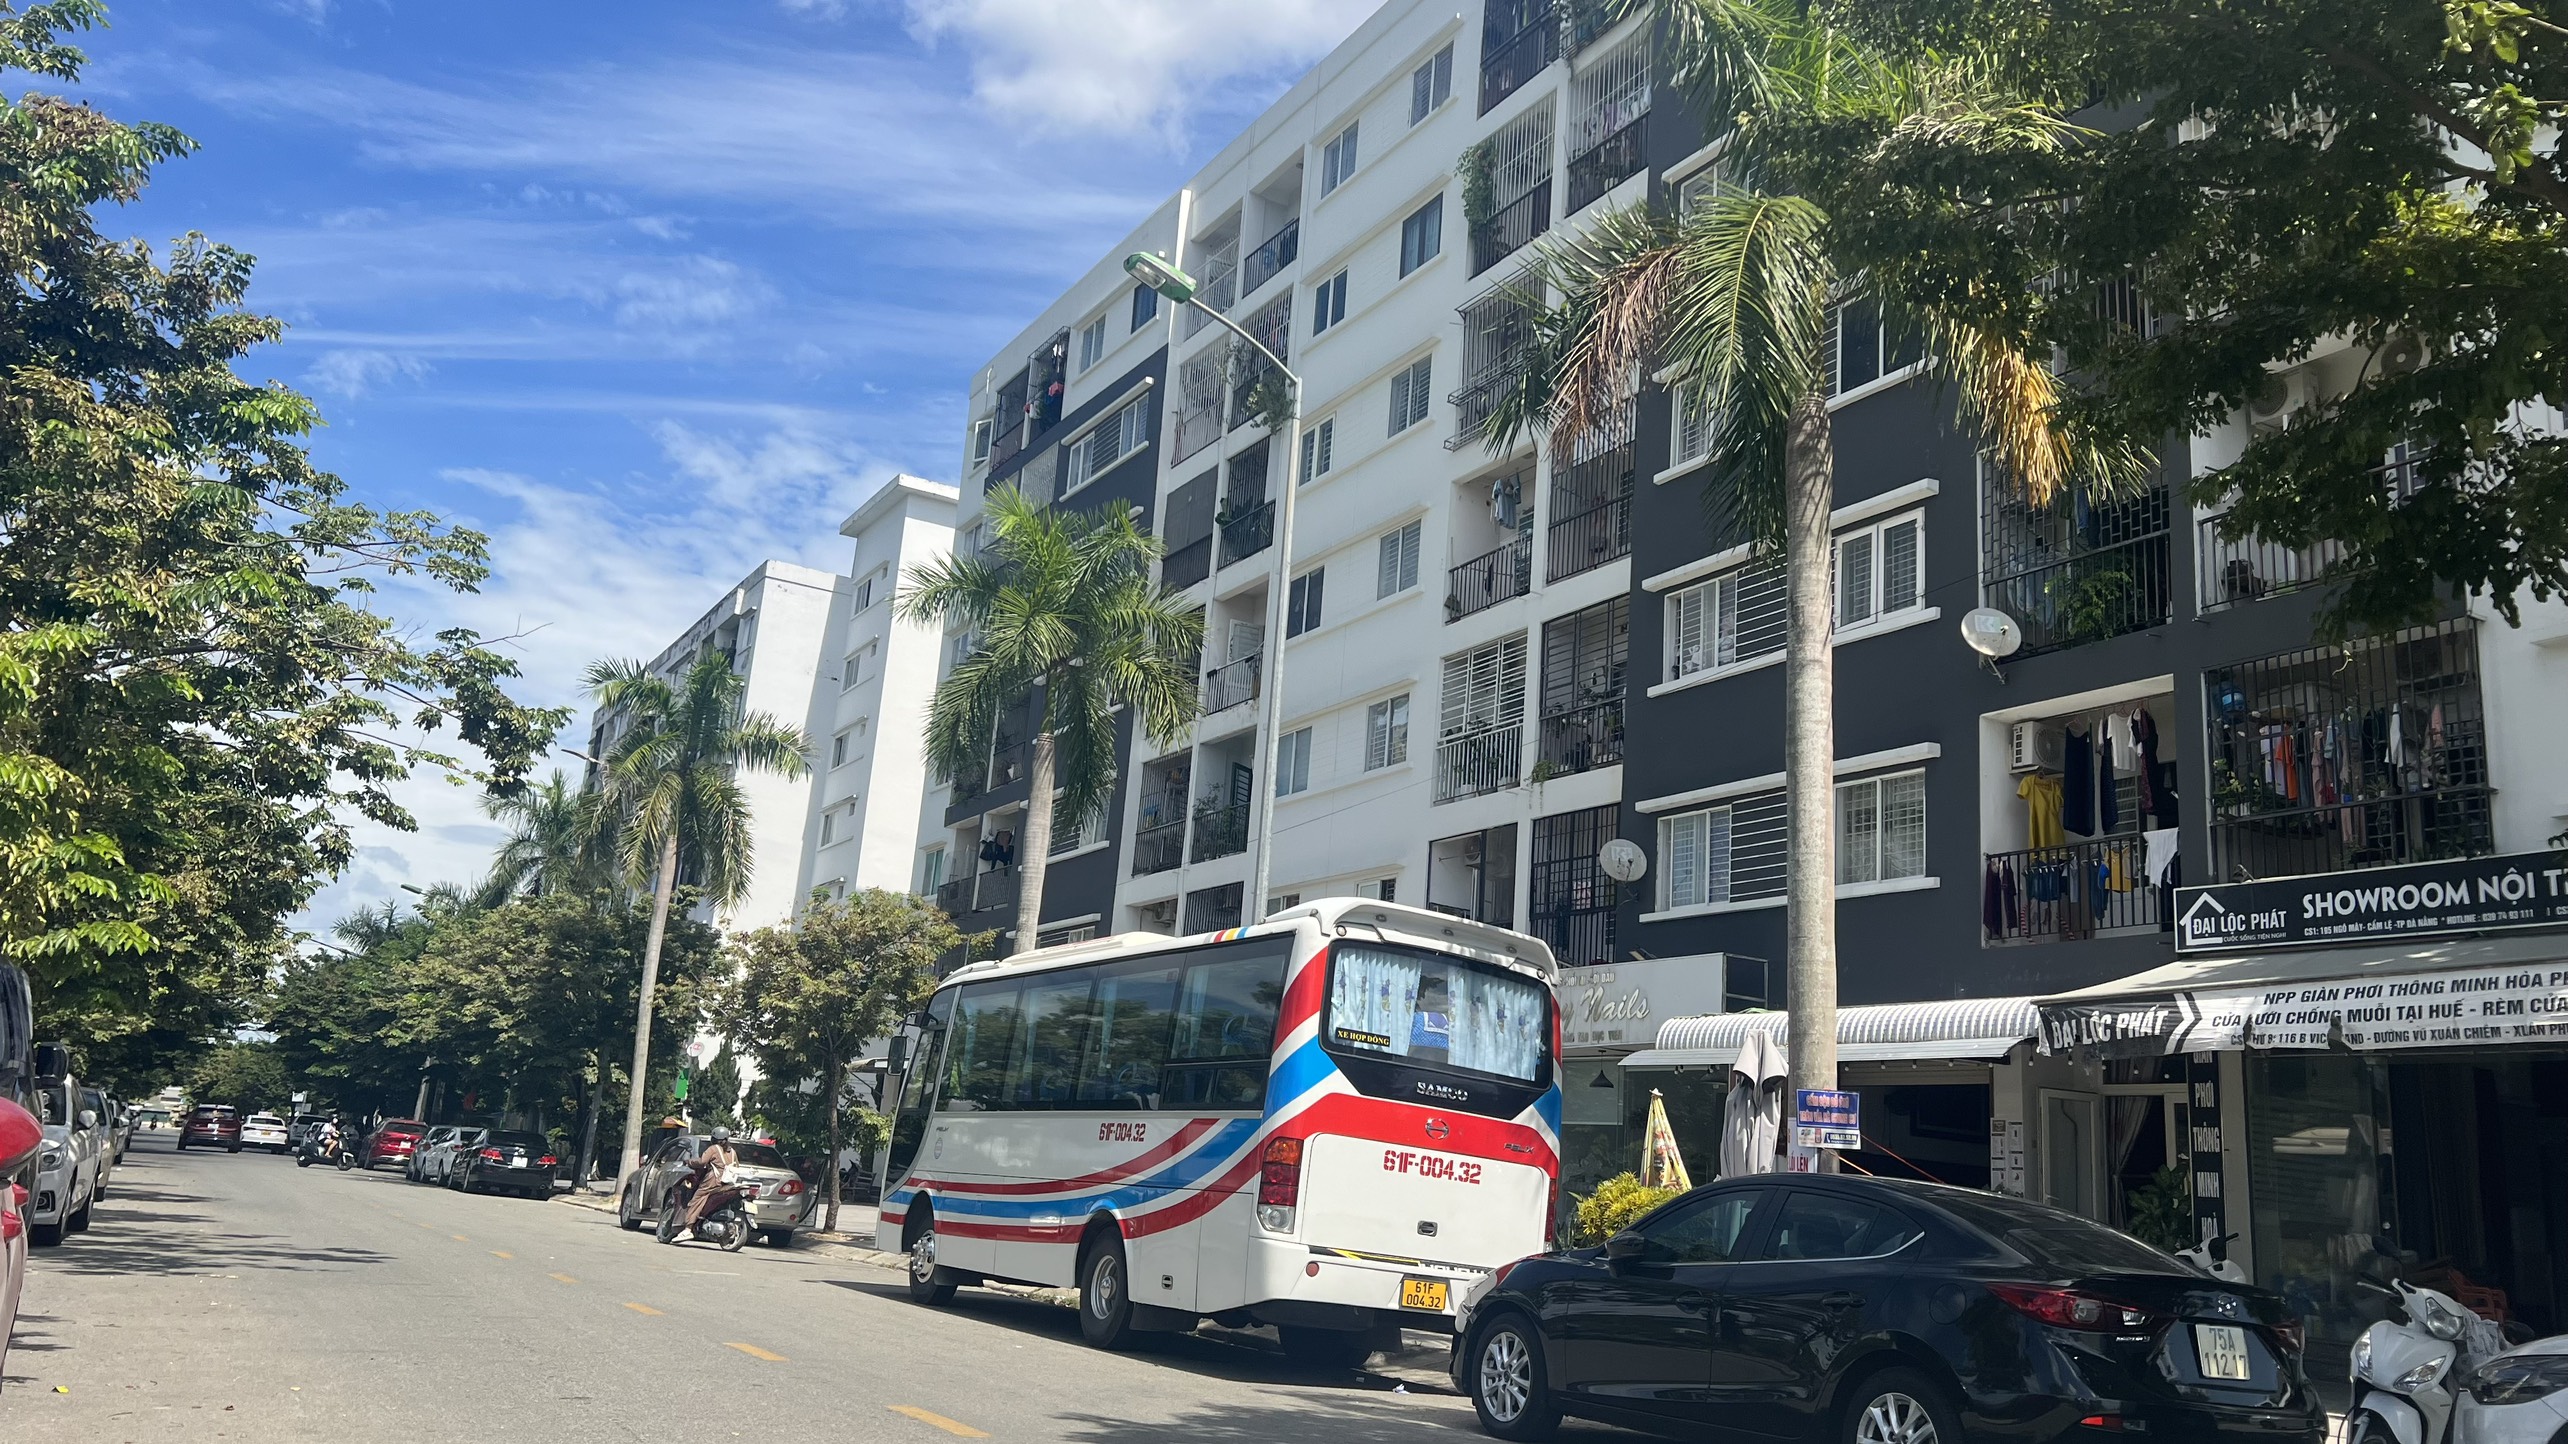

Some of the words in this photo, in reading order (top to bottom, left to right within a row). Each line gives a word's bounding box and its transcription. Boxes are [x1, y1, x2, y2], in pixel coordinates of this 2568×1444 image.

[2303, 878, 2470, 919] SHOWROOM
[2477, 867, 2535, 905] NỘI
[2192, 917, 2215, 937] ĐẠI
[2221, 913, 2246, 935] LỘC
[2251, 909, 2287, 930] PHÁT
[2263, 991, 2296, 1005] NPP
[2301, 987, 2339, 1003] GIÀN
[2343, 984, 2383, 1000] PHƠI
[2389, 980, 2445, 997] THÔNG
[2451, 977, 2499, 993] MINH
[2506, 971, 2543, 989] HÒA
[1580, 986, 1650, 1023] Nails
[2212, 1012, 2241, 1027] CỬA
[2253, 1009, 2282, 1025] ƯỚI
[2347, 1003, 2390, 1023] MUỖI
[2397, 1005, 2422, 1023] TẠI
[2429, 998, 2465, 1019] HUẾ
[2483, 997, 2524, 1016] RÈM
[2116, 1004, 2169, 1040] PHÁT
[1337, 1030, 1349, 1039] XE
[1350, 1032, 1367, 1042] HỢP
[2279, 1033, 2296, 1044] 116
[1416, 1081, 1469, 1102] SAMCO
[1099, 1122, 1146, 1142] 61F-004.32
[2192, 1122, 2220, 1153] THÔNG
[1383, 1150, 1482, 1185] 61F-004.32
[2197, 1172, 2220, 1198] MINH
[1406, 1294, 1440, 1308] 004.32
[1415, 1282, 1434, 1294] 61F
[2209, 1328, 2236, 1351] 75A
[2205, 1353, 2247, 1377] 112.17
